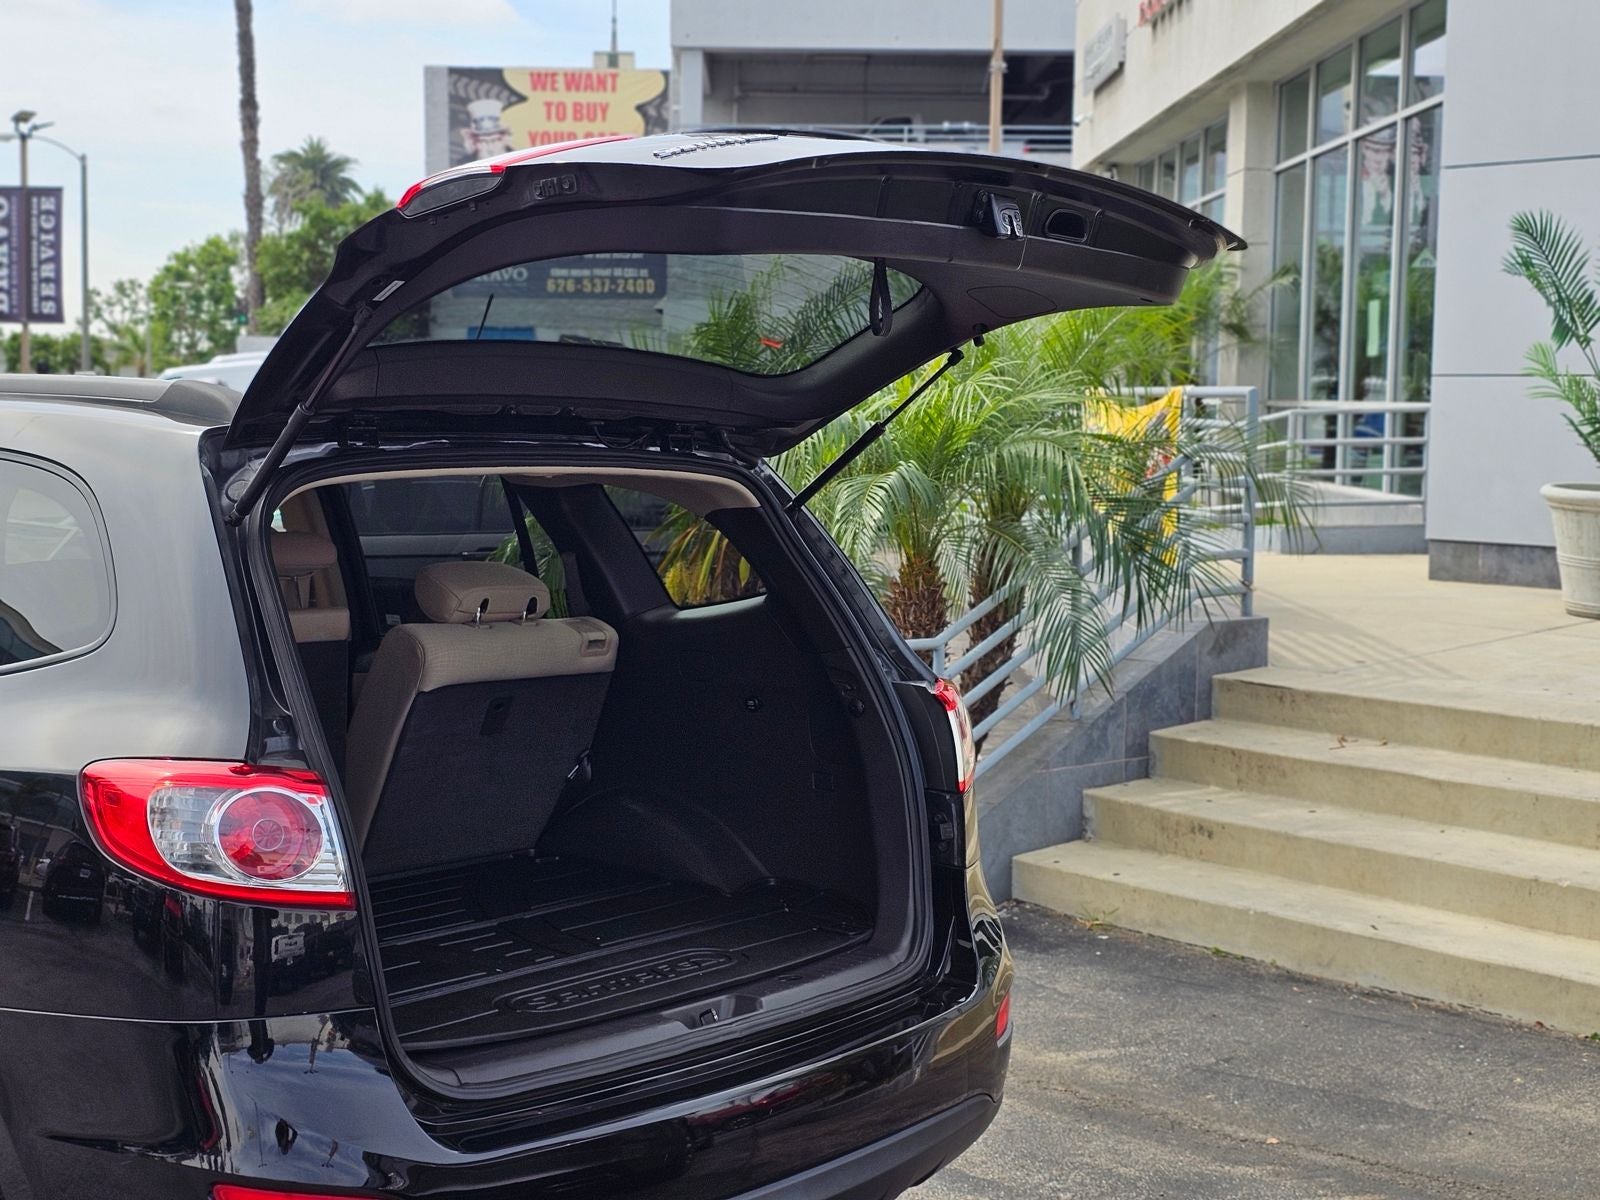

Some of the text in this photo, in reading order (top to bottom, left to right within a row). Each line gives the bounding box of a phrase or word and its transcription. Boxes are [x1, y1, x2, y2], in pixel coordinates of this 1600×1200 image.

[529, 72, 619, 93] WE WANT
[543, 102, 609, 123] TO BUY
